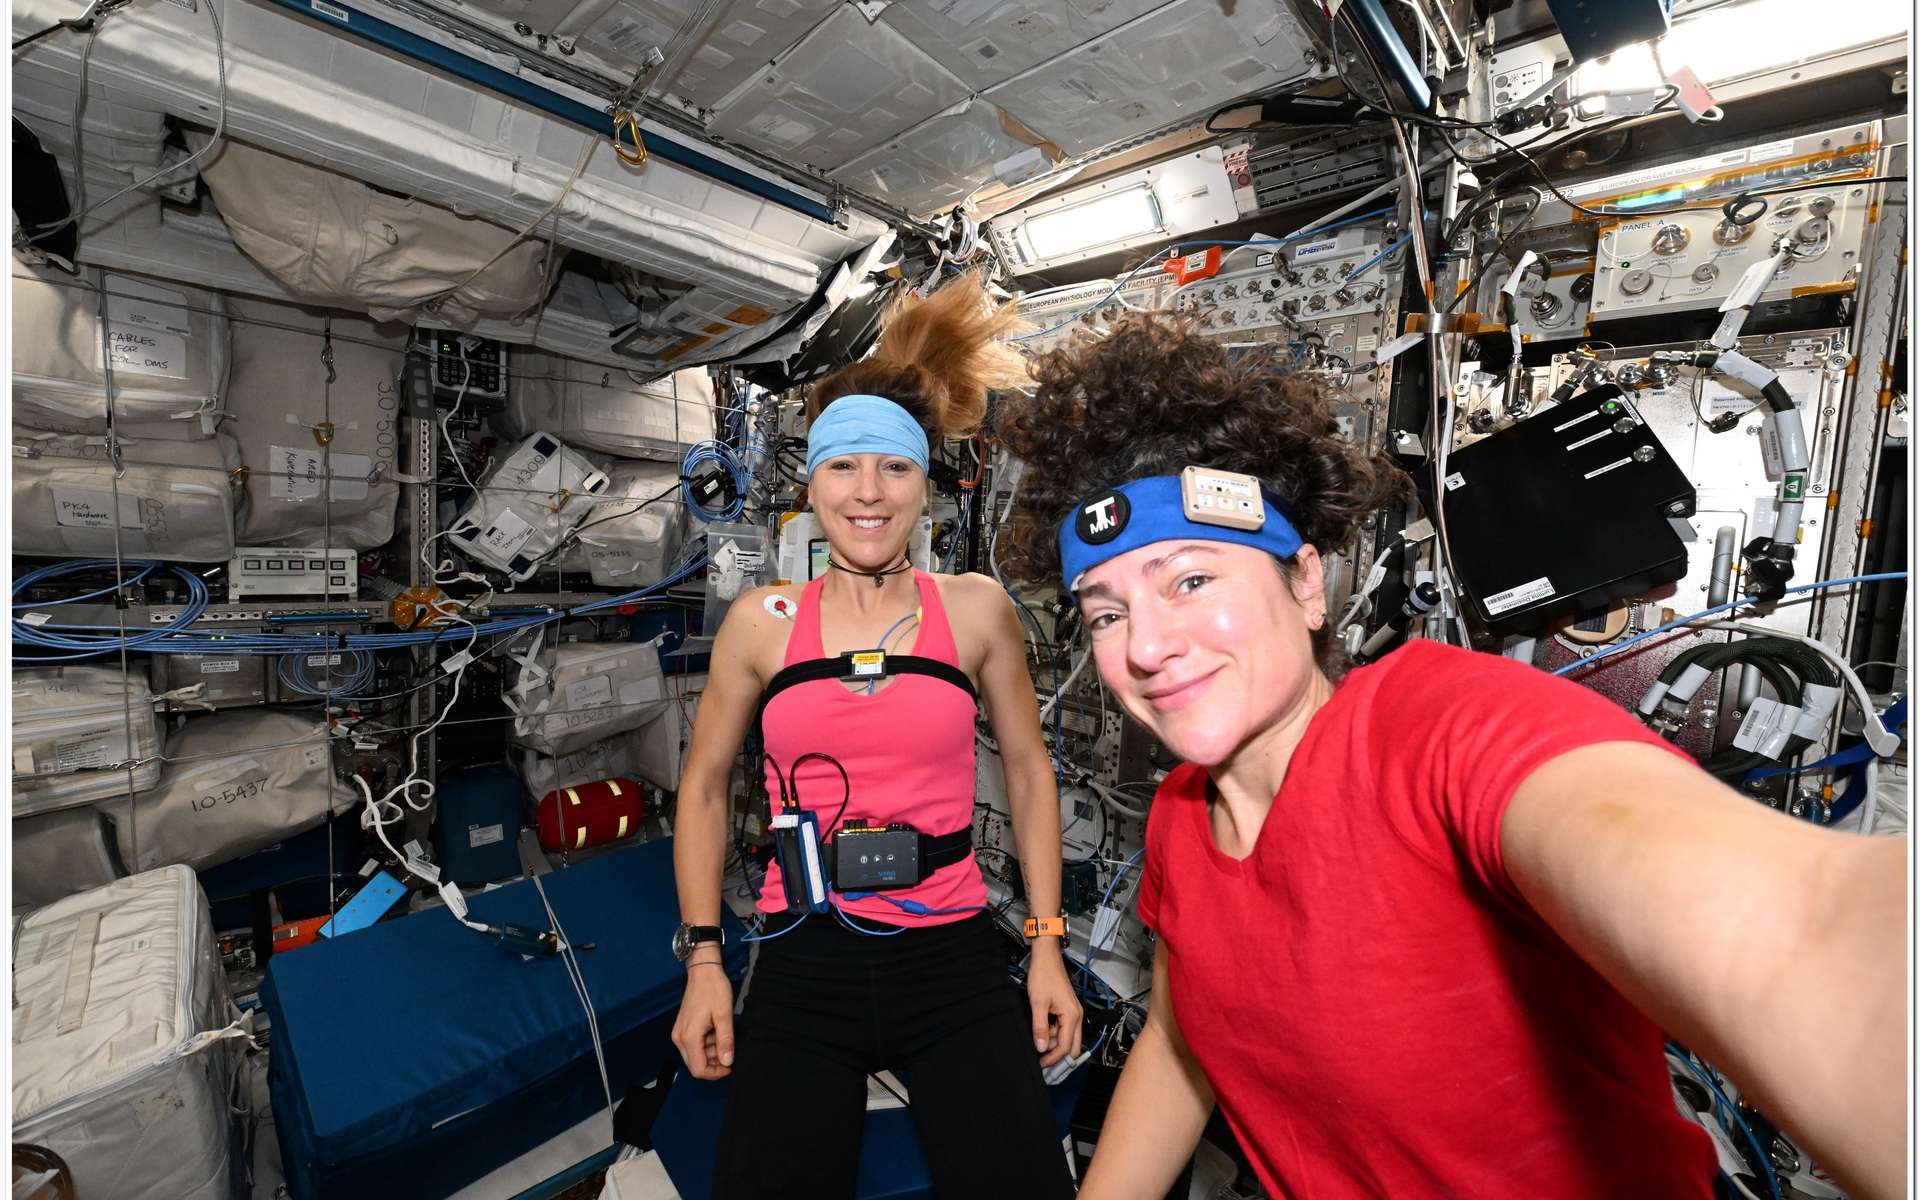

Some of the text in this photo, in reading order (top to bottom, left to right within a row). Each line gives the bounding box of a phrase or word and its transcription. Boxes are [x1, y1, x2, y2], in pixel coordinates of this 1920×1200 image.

[1622, 222, 1652, 232] PANEL
[1029, 298, 1059, 310] EUROPEAN
[1059, 289, 1097, 304] PHYSIOLOGY
[1097, 284, 1127, 296] MODES
[109, 331, 156, 347] CABLES
[115, 344, 138, 353] FOR
[145, 359, 169, 369] DMS
[191, 777, 268, 812] 1.0-5437
